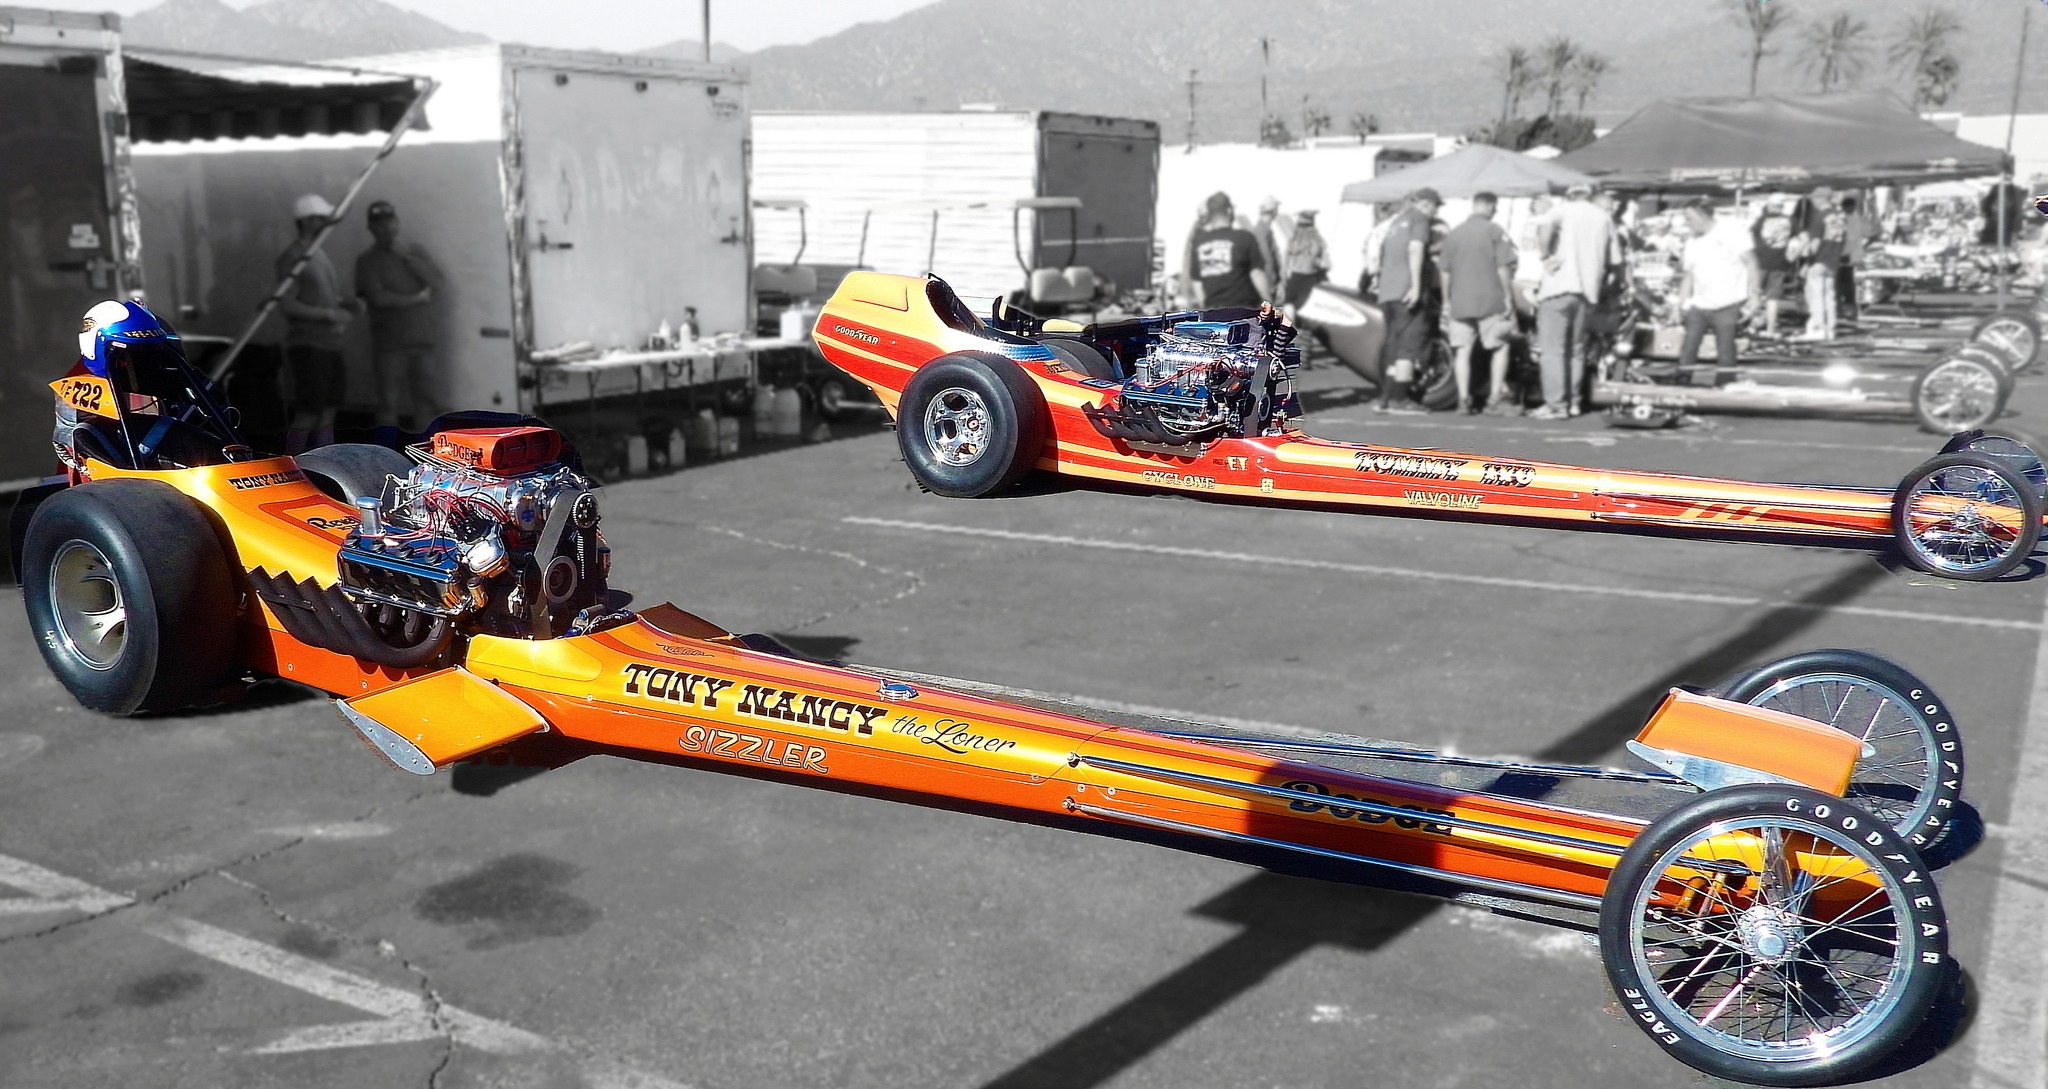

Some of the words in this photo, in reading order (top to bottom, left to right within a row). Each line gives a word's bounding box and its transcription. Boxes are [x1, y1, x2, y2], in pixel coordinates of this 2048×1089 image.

[834, 324, 879, 345] GOODYEAR
[71, 380, 103, 411] 722
[1142, 470, 1215, 490] CYCLONE
[1403, 489, 1485, 510] VALVOLINE
[624, 662, 735, 709] TONY
[737, 684, 889, 736] NANCY
[891, 715, 928, 738] the
[920, 718, 1017, 755] Loner
[678, 725, 829, 774] SIZZLER
[1910, 689, 1959, 845] GOODYEAR
[1786, 798, 1942, 965] GOODYEAR
[1623, 988, 1681, 1045] EAGLE
